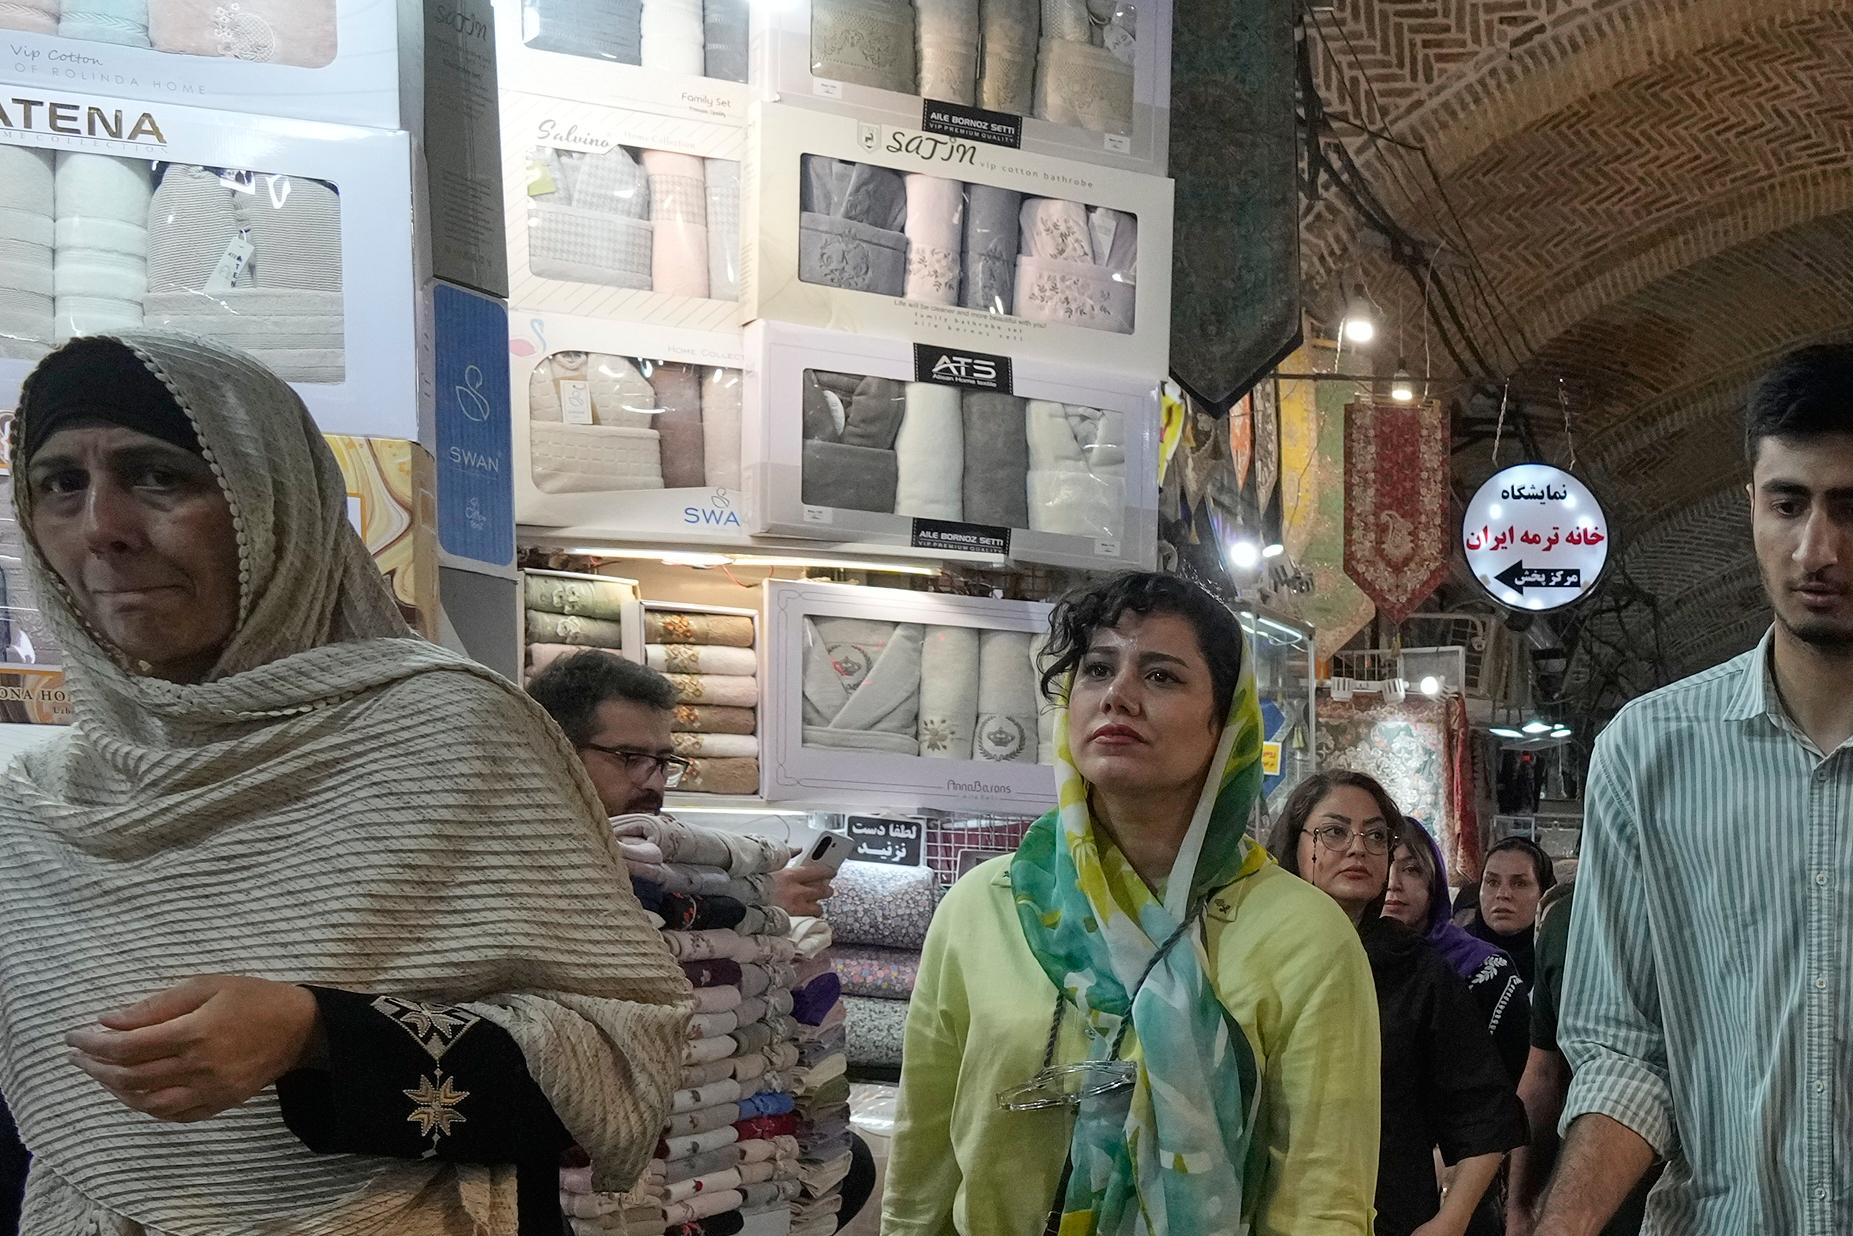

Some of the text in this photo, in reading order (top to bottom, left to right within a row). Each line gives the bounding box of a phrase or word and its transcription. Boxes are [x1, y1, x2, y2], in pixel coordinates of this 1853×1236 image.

[10, 43, 104, 66] Vip Cotton
[14, 62, 206, 95] OF ROLINDA HOME
[681, 92, 732, 108] Family Set
[930, 111, 1015, 134] AILE BORNOZ SETTI
[944, 124, 980, 136] PREMIUM
[981, 132, 1014, 142] QUALITY
[36, 134, 168, 154] COLLECTION
[537, 119, 609, 148] Salvino
[979, 161, 997, 172] vip
[1001, 166, 1039, 178] cotton
[1042, 172, 1094, 189] bathrobe
[931, 354, 998, 379] ATS
[449, 446, 499, 473] SWAN
[1501, 484, 1567, 505] نمایشگاه
[684, 507, 741, 527] SWA
[919, 530, 1003, 547] AILE BORNOZ SETTI
[933, 542, 968, 551] PREMIUM
[970, 546, 1003, 554] QUALITY
[1466, 524, 1605, 551] خانه ترمه ایران
[1514, 570, 1578, 586] مرکز پخش
[947, 779, 1012, 794] AnnaBarons
[852, 823, 918, 840] لطفا دست
[857, 841, 907, 862] نزنید
